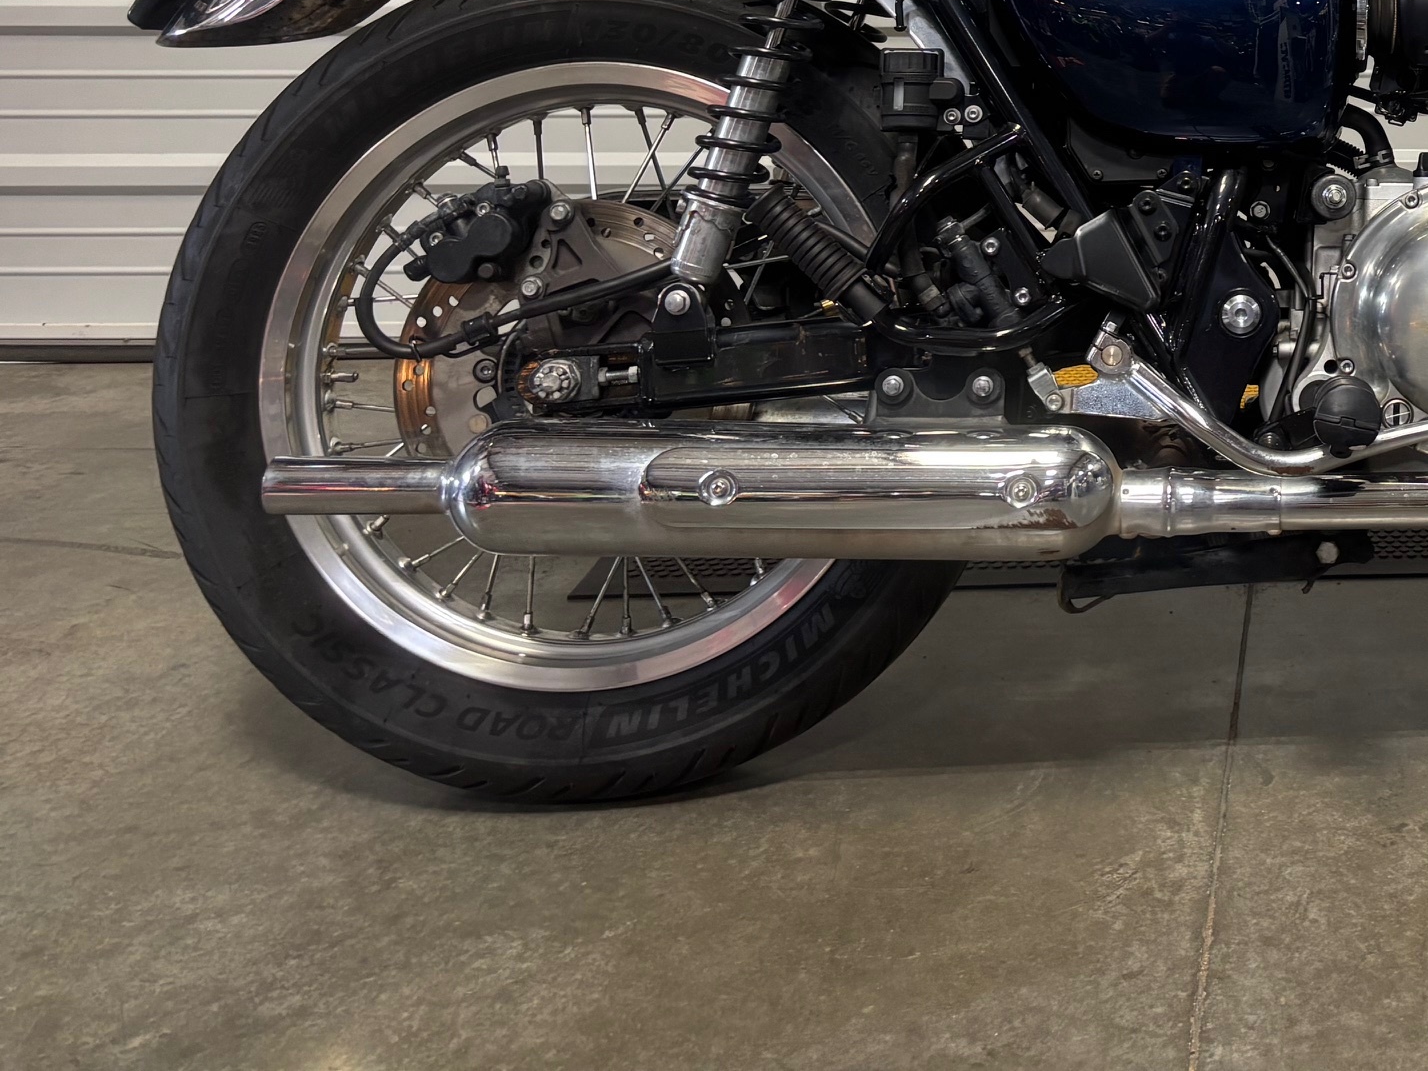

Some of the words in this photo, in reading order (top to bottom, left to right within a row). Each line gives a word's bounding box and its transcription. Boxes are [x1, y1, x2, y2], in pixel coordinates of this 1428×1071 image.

[289, 603, 446, 720] CLASSIC
[605, 603, 836, 739] MICHELIN
[455, 704, 582, 742] ROAD
